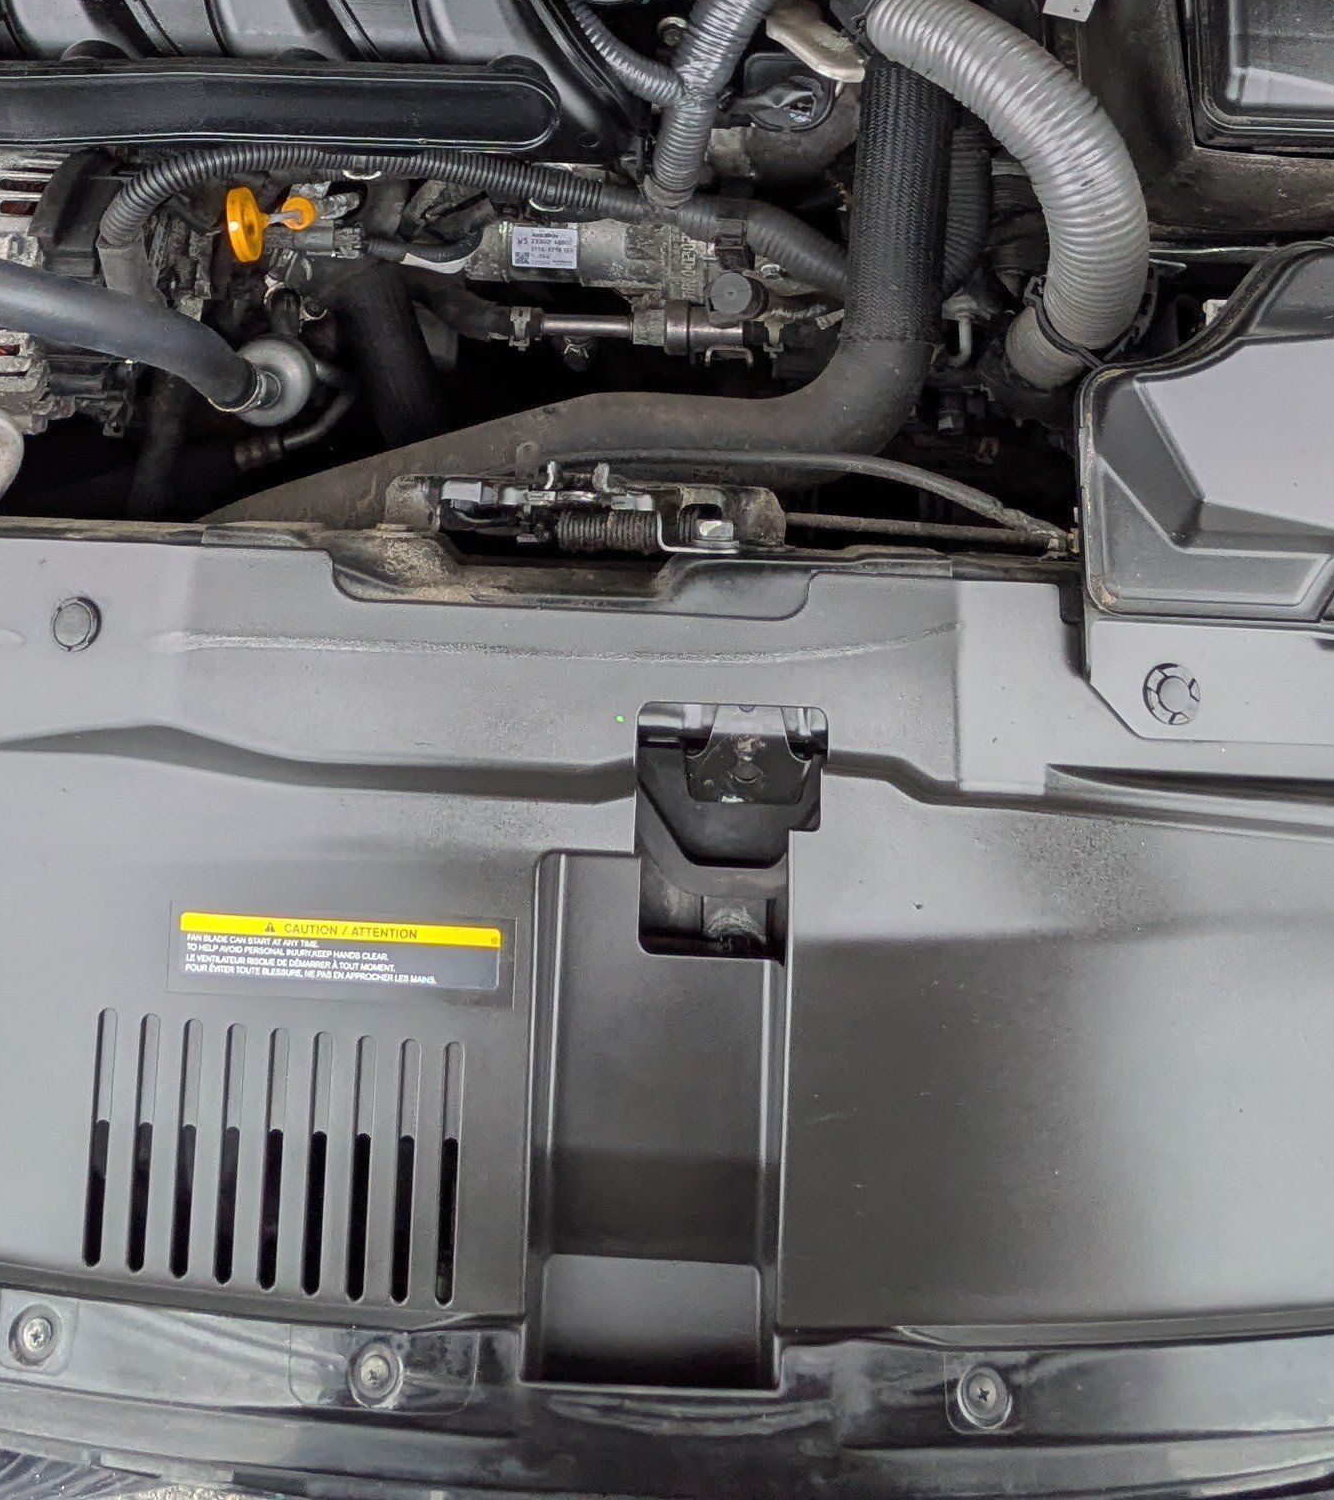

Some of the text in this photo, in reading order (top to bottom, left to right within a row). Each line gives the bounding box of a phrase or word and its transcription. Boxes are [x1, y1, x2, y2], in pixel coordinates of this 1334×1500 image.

[284, 923, 417, 939] CAUTION / ATTENTION
[187, 933, 319, 948] FAN BLADE CAN START AT ANY TIME.
[187, 943, 197, 951] TO
[199, 944, 218, 952] HELP
[219, 945, 243, 953] AVOID
[244, 946, 284, 956] PERSONAL
[333, 950, 361, 959] HANDS
[362, 952, 388, 961] CLEAR.
[186, 953, 396, 972] LE VENTILATEUR RISQUE DE DÉMARRER À TOUT MOMENT.
[185, 962, 436, 985] POUR ÉVITER TOUTE BLESSURE, NE PAS EN APPROCHER LES MAINS.
